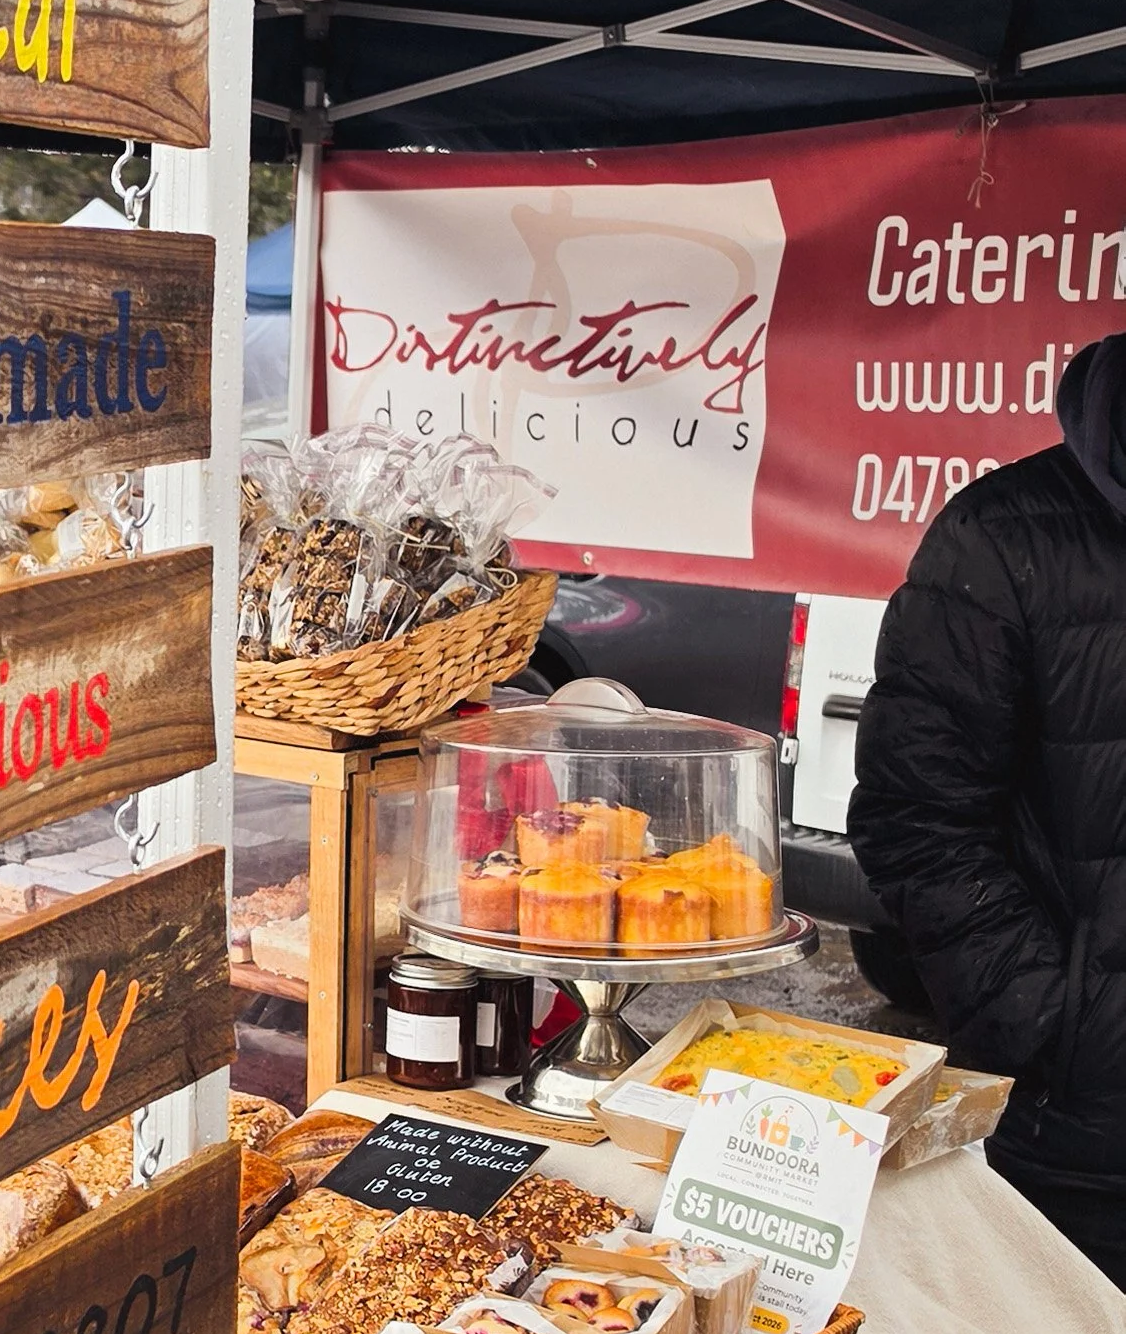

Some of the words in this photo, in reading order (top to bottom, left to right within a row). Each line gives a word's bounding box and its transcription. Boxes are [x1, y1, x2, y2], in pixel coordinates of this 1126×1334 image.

[868, 209, 1126, 307] Caterin
[325, 294, 766, 413] Distinctively
[856, 343, 1073, 414] www.d
[374, 389, 750, 450] delicious
[852, 453, 1001, 523] 0478
[367, 1134, 439, 1156] Animal
[450, 1146, 529, 1173] Products
[384, 1119, 440, 1141] Made
[446, 1134, 529, 1158] without
[726, 1135, 820, 1177] BUNDOORA
[386, 1163, 453, 1187] Gluten
[723, 1151, 780, 1175] COMMUNITY
[784, 1170, 819, 1187] MARKET
[755, 1172, 783, 1185] @RMIT
[681, 1186, 713, 1216] $5
[717, 1197, 835, 1260] VOUCHERS
[773, 1258, 815, 1286] Here
[767, 1296, 786, 1308] stall
[762, 1316, 782, 1330] 2026
